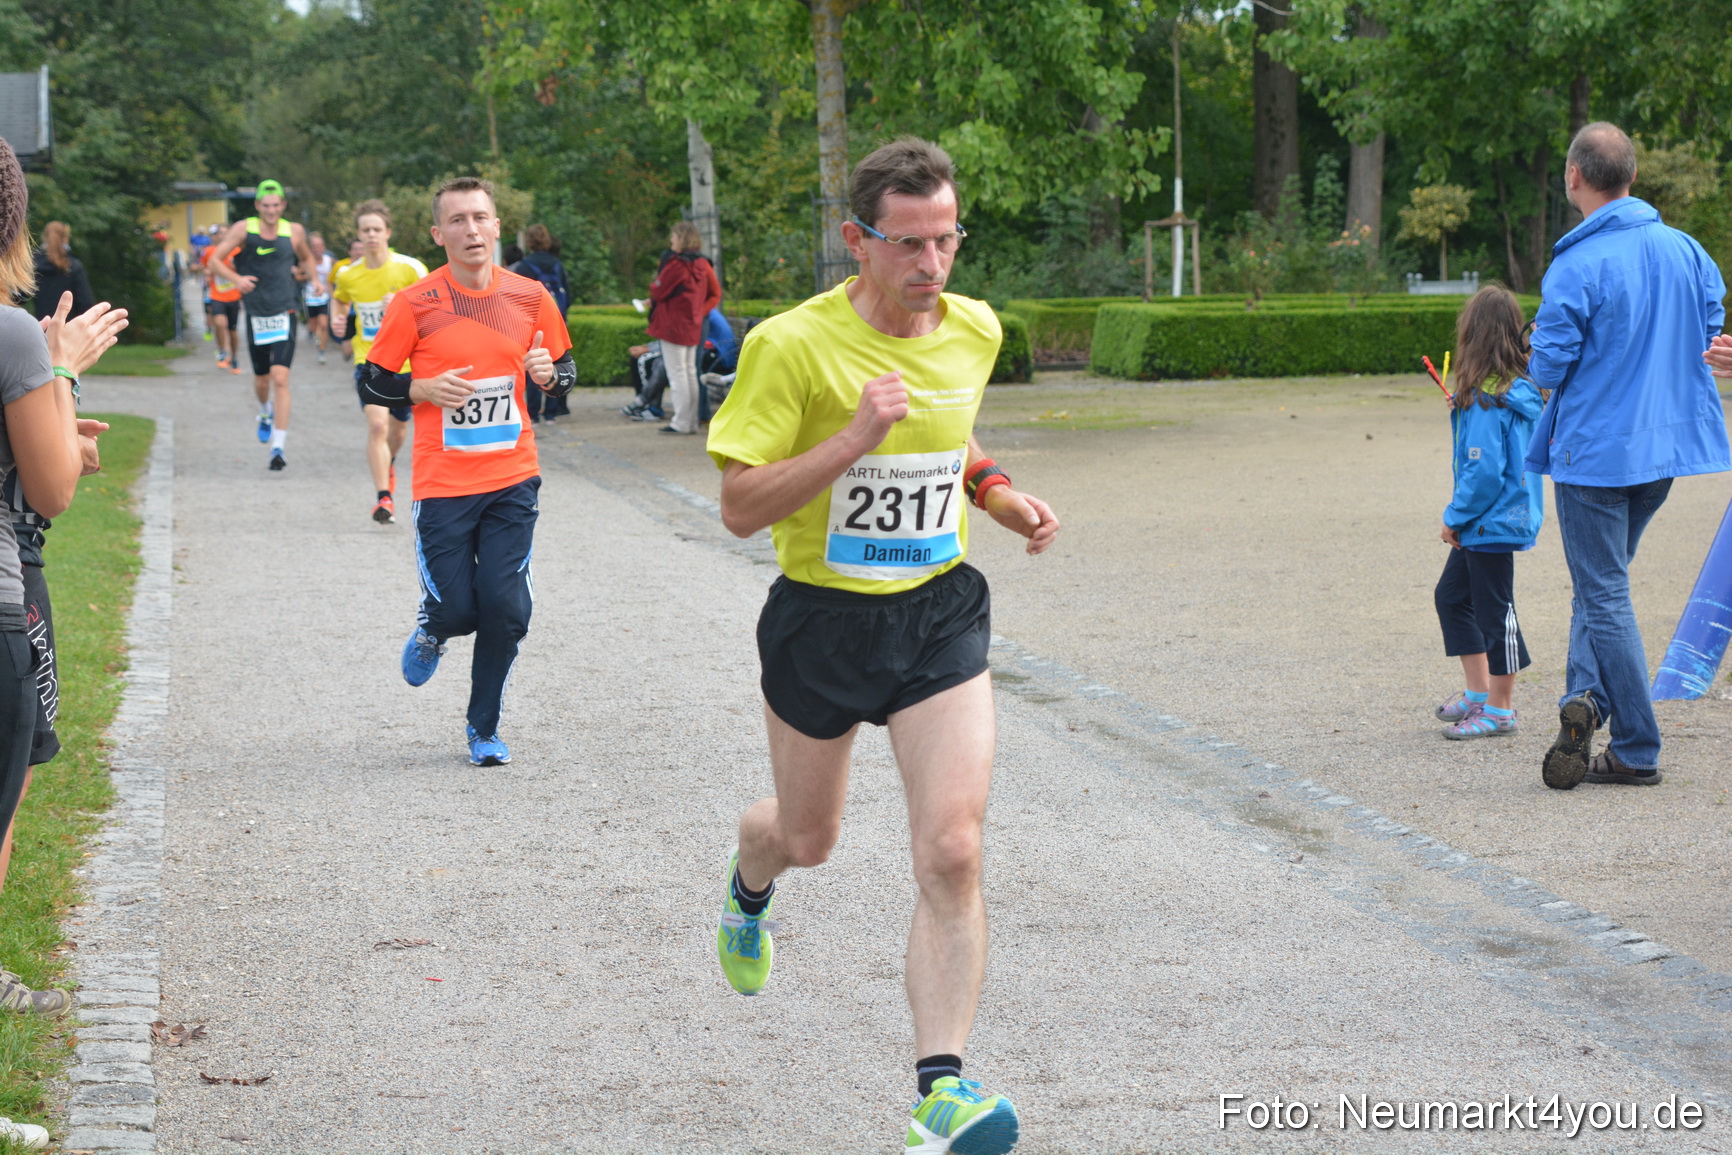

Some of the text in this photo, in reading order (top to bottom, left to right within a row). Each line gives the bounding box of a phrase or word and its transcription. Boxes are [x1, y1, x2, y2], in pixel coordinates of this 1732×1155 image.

[451, 394, 511, 425] 3377
[846, 465, 948, 480] ARTL Neumarkt
[845, 482, 954, 532] 2317
[864, 543, 931, 562] Damian
